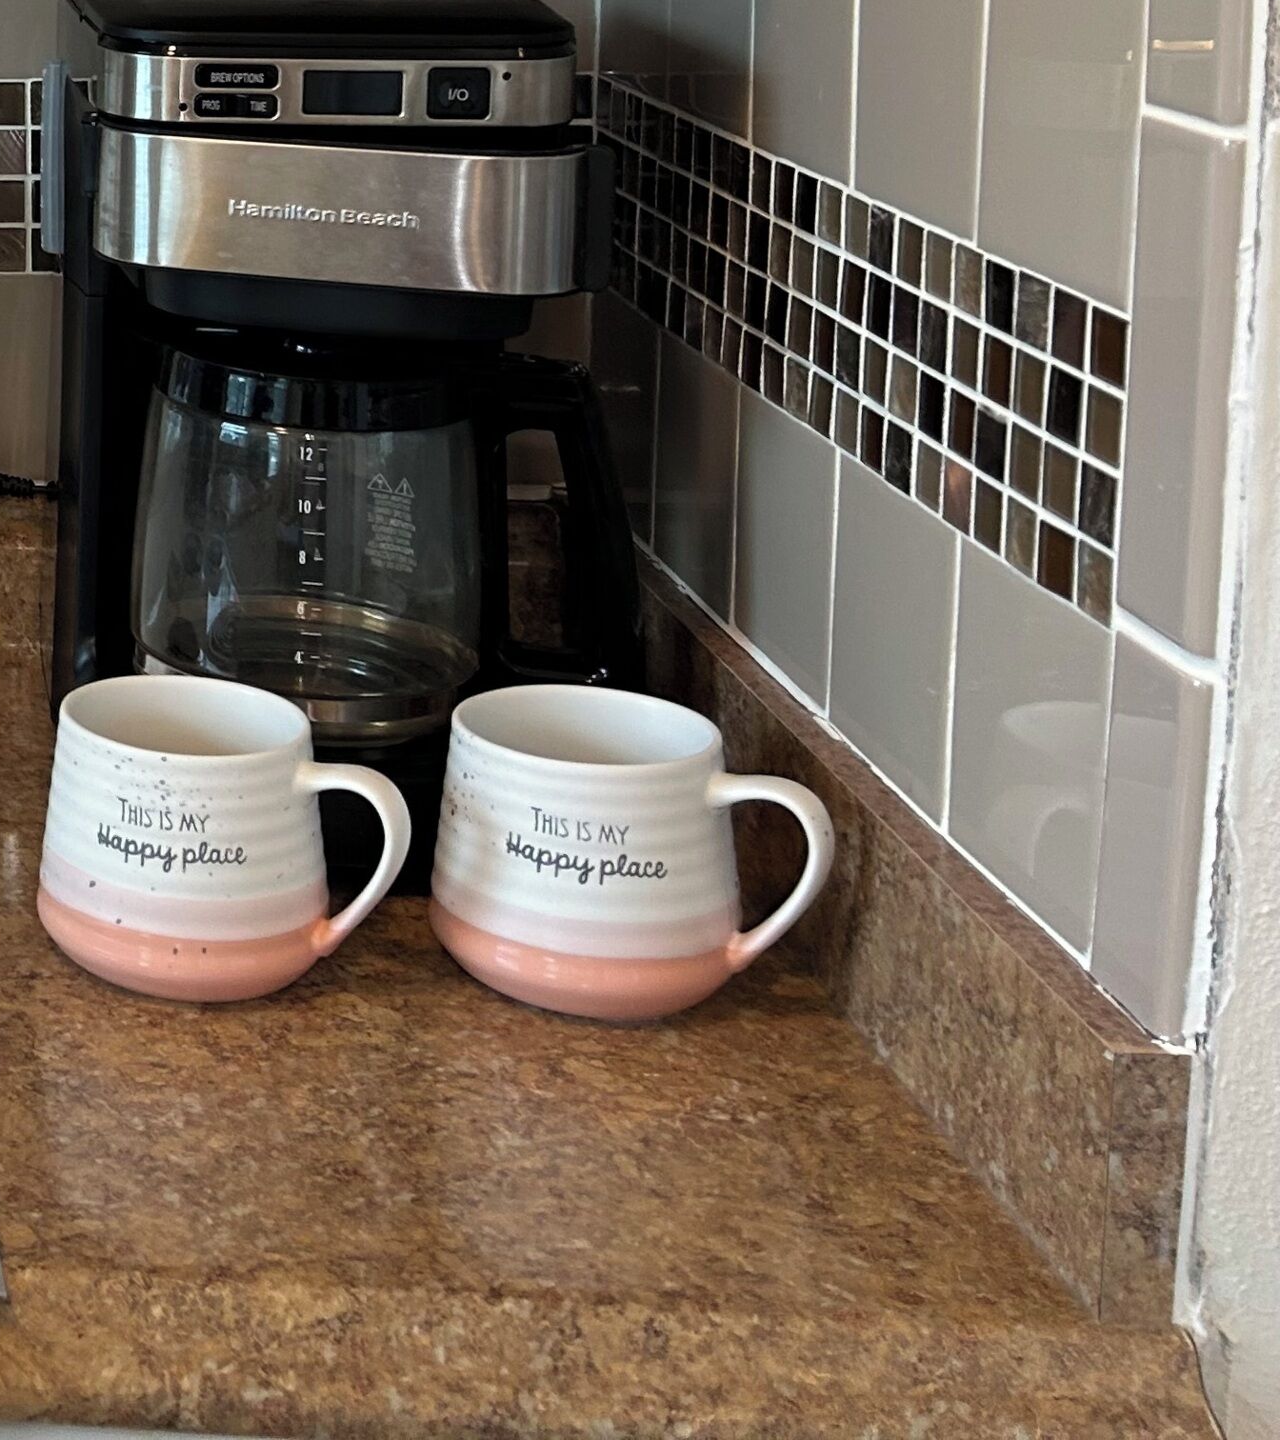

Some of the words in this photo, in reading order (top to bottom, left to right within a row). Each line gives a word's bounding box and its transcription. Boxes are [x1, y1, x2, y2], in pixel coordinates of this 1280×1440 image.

[210, 71, 232, 83] BREW
[232, 72, 265, 83] OPTIONS
[227, 198, 337, 223] Hamilton
[340, 208, 421, 230] Beach
[300, 446, 314, 461] 12
[298, 499, 312, 514] 10
[299, 550, 306, 565] 8
[117, 795, 152, 827] THIS
[159, 810, 173, 831] IS
[179, 813, 210, 833] MY
[531, 806, 569, 838] THIS
[576, 820, 592, 842] IS
[598, 824, 629, 845] MY
[97, 822, 177, 873] Happy
[182, 841, 247, 873] place
[506, 831, 595, 885] Happy
[599, 854, 668, 885] place
